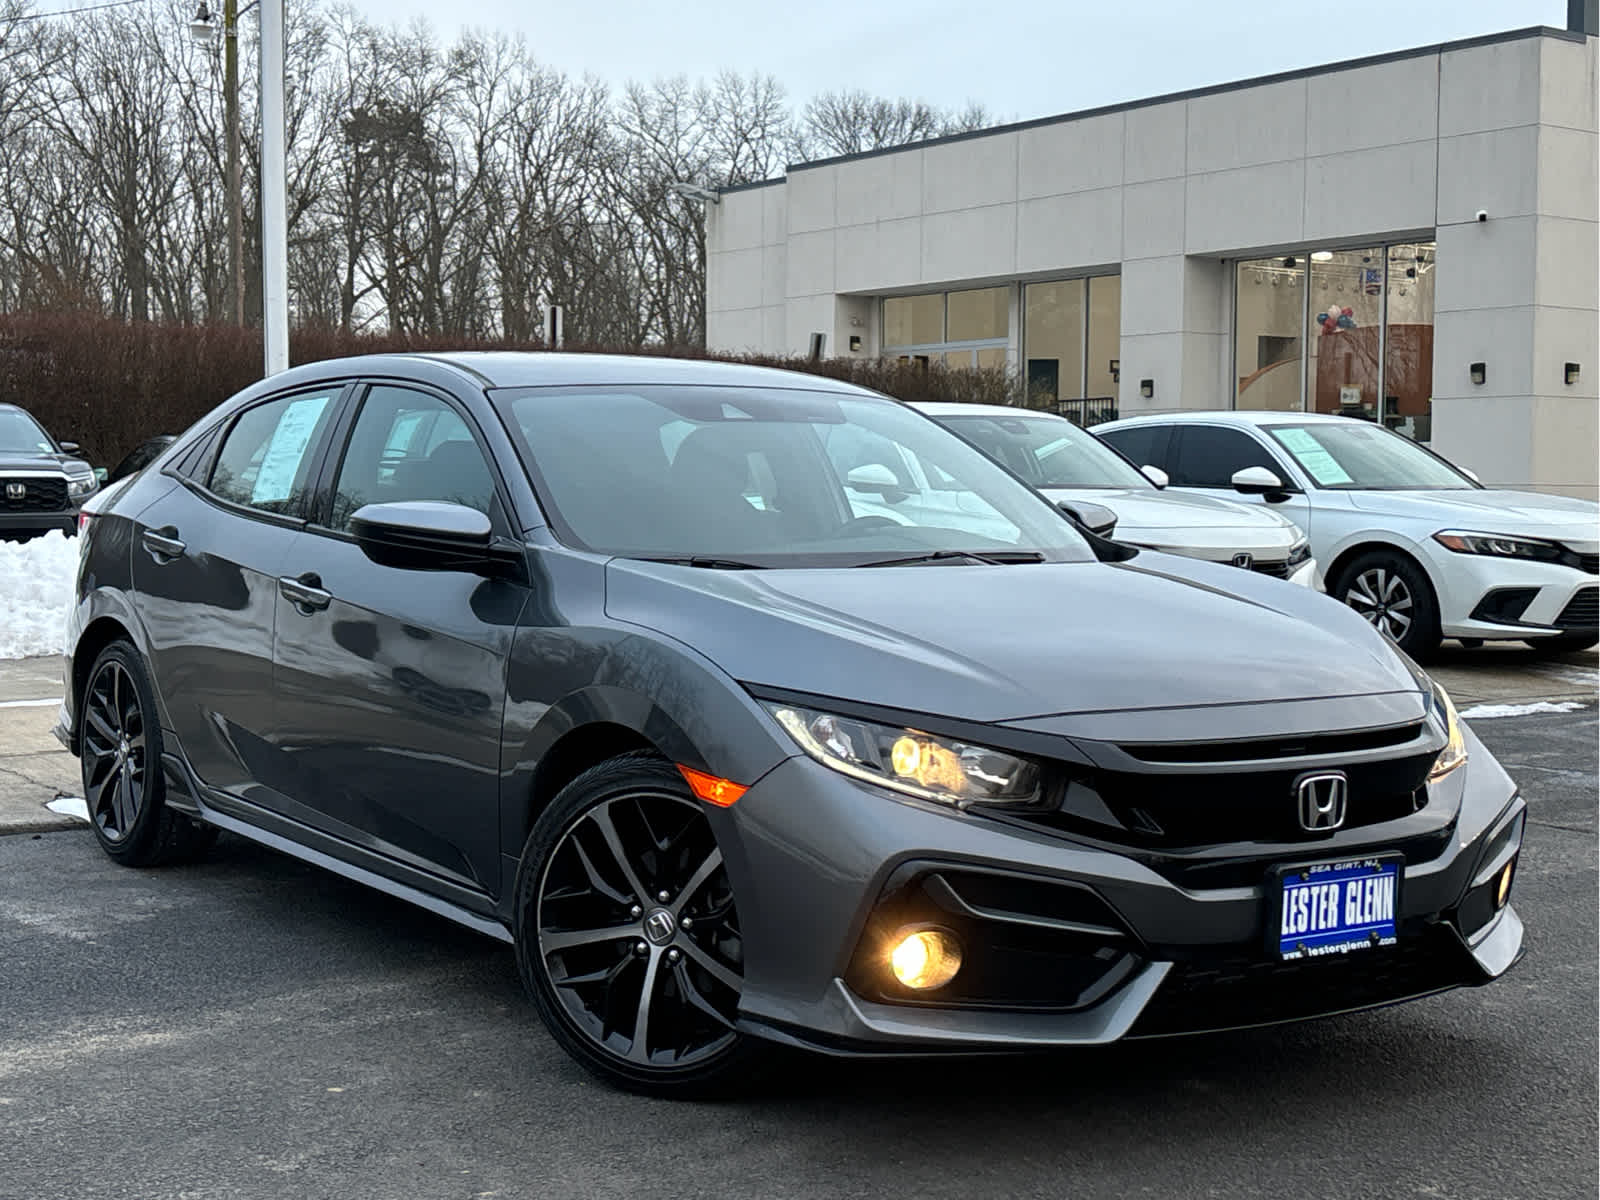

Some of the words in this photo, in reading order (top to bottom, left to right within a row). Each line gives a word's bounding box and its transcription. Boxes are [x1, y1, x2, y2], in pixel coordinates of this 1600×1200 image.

[1309, 864, 1331, 874] SEA
[1281, 884, 1340, 936] LESTER
[1345, 876, 1394, 926] GLENN
